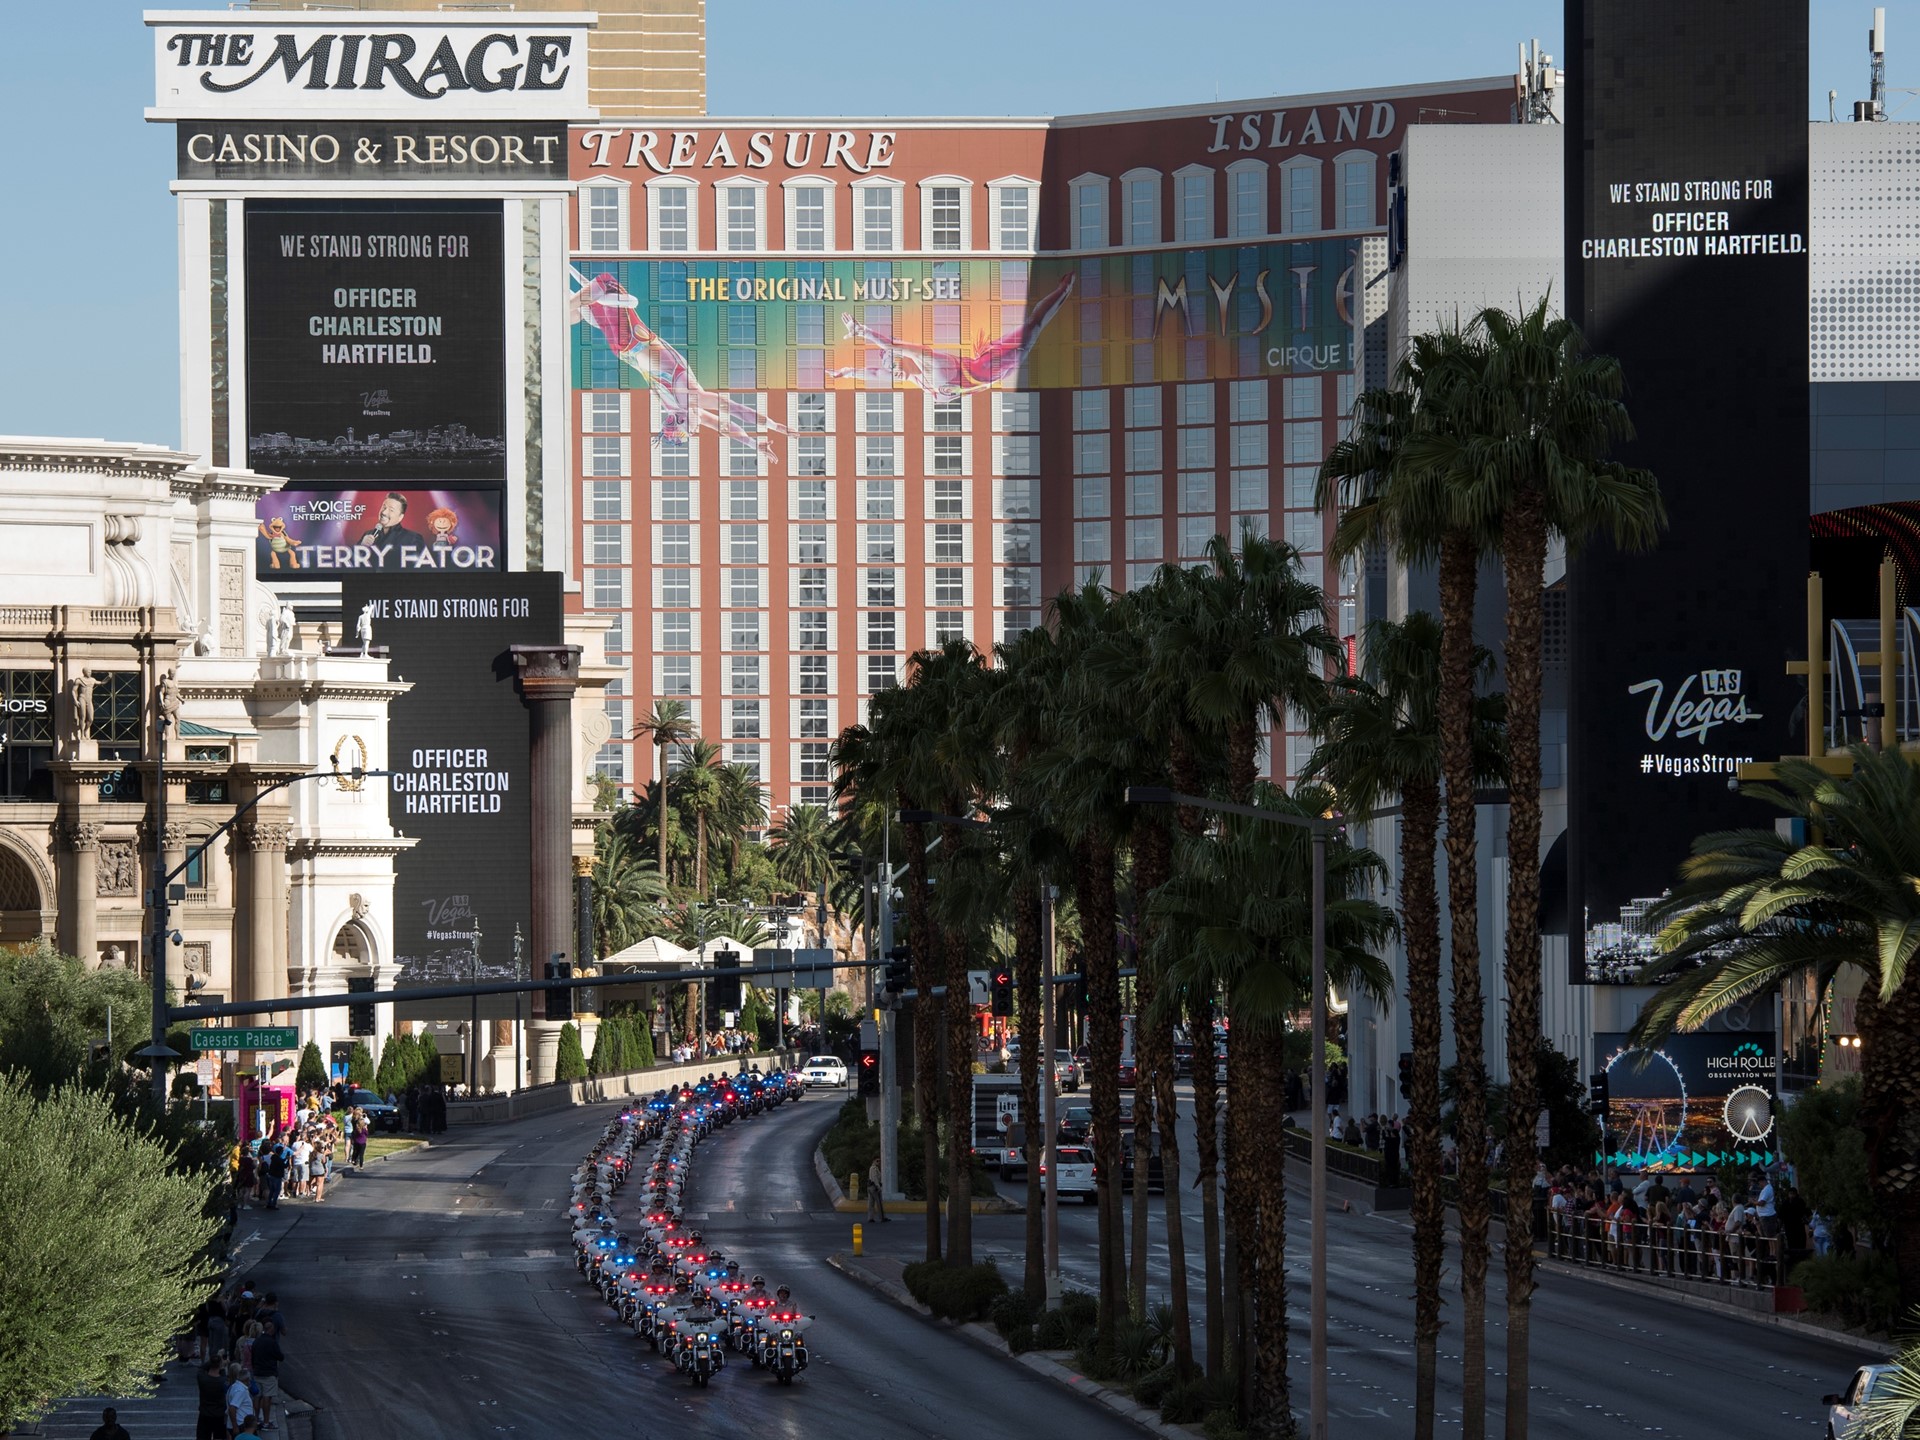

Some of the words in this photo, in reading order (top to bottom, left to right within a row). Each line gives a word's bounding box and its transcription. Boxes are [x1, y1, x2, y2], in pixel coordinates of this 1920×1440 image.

[166, 33, 255, 67] THE
[200, 33, 573, 100] MIRAGE
[1207, 101, 1397, 154] ISLAND
[187, 133, 341, 164] CASINO
[354, 137, 382, 164] &
[393, 135, 559, 165] RESORT
[580, 128, 897, 174] TREASURE
[1609, 183, 1631, 204] WE
[1635, 181, 1680, 203] STAND
[1684, 180, 1741, 202] STRONG
[1745, 179, 1773, 200] FOR
[1652, 211, 1730, 233] OFFICER
[280, 235, 305, 258] WE
[310, 235, 362, 258] STAND
[367, 235, 433, 258] STRONG
[437, 235, 470, 258] FOR
[1581, 236, 1699, 259] CHARLESTON
[1704, 233, 1807, 256] HARTFIELD.
[333, 287, 417, 308] OFFICER
[686, 277, 730, 301] THE
[735, 277, 846, 301] ORIGINAL
[852, 276, 962, 301] MUST-SEE
[309, 315, 442, 336] CHARLESTON
[322, 343, 437, 364] HARTFIELD.
[1266, 343, 1341, 370] CIRQUE
[290, 505, 306, 513] THE
[308, 500, 352, 513] VOICE
[354, 505, 367, 513] OF
[292, 513, 363, 521] ENTERTAINMENT
[295, 544, 394, 569] TERRY
[400, 544, 495, 569] FATOR
[368, 599, 389, 618] WE
[394, 598, 438, 618] STAND
[442, 598, 498, 618] STRONG
[502, 598, 530, 618] FOR
[1703, 671, 1739, 694] LAS
[1628, 674, 1763, 745] Vegas
[411, 748, 488, 769] OFFICER
[392, 772, 509, 792] CHARLESTON
[405, 794, 501, 814] HARTFIELD
[421, 897, 478, 926] Vegas
[194, 1033, 239, 1047] Caesars
[246, 1032, 282, 1046] Palace
[1707, 1057, 1738, 1069] HIGH
[999, 1102, 1017, 1113] Lite
